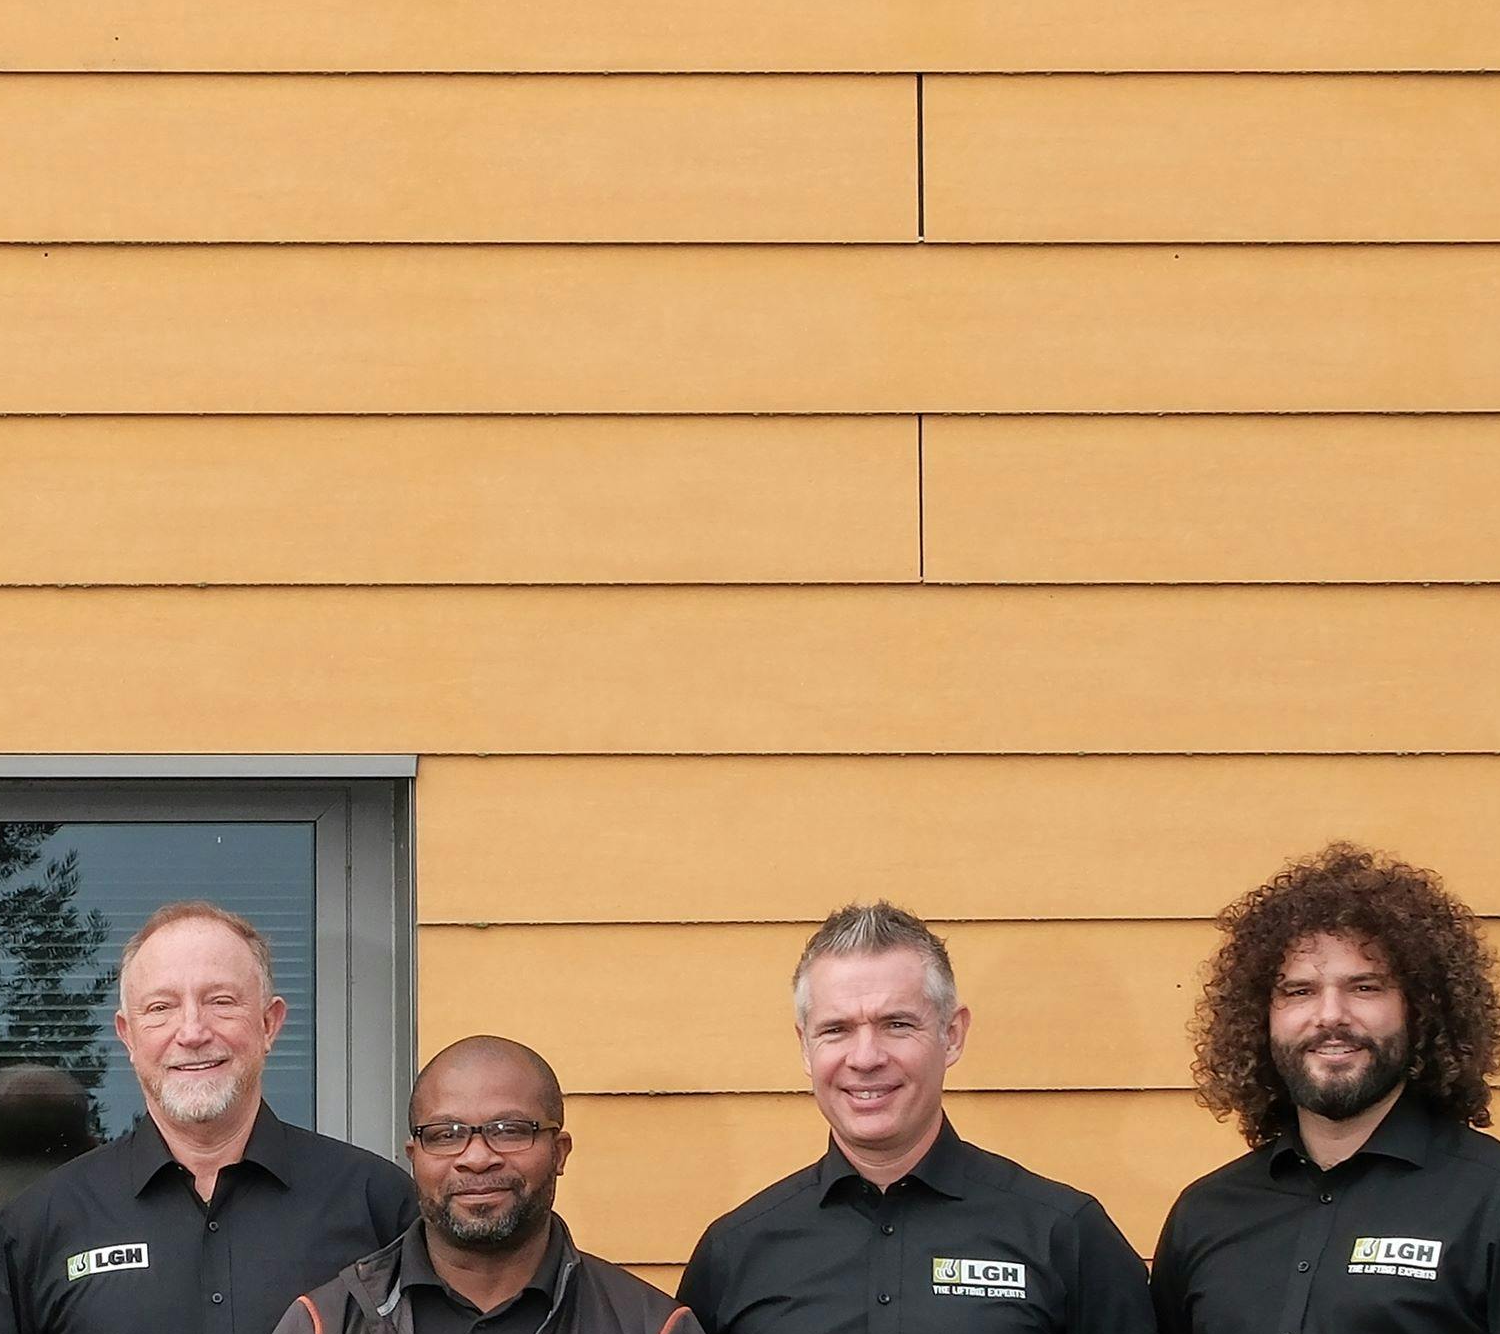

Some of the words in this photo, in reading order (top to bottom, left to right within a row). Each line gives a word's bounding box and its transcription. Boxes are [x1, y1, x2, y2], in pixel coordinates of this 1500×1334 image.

[96, 1248, 143, 1267] LGH
[1384, 1243, 1434, 1262] LGH
[968, 1264, 1018, 1282] LGH
